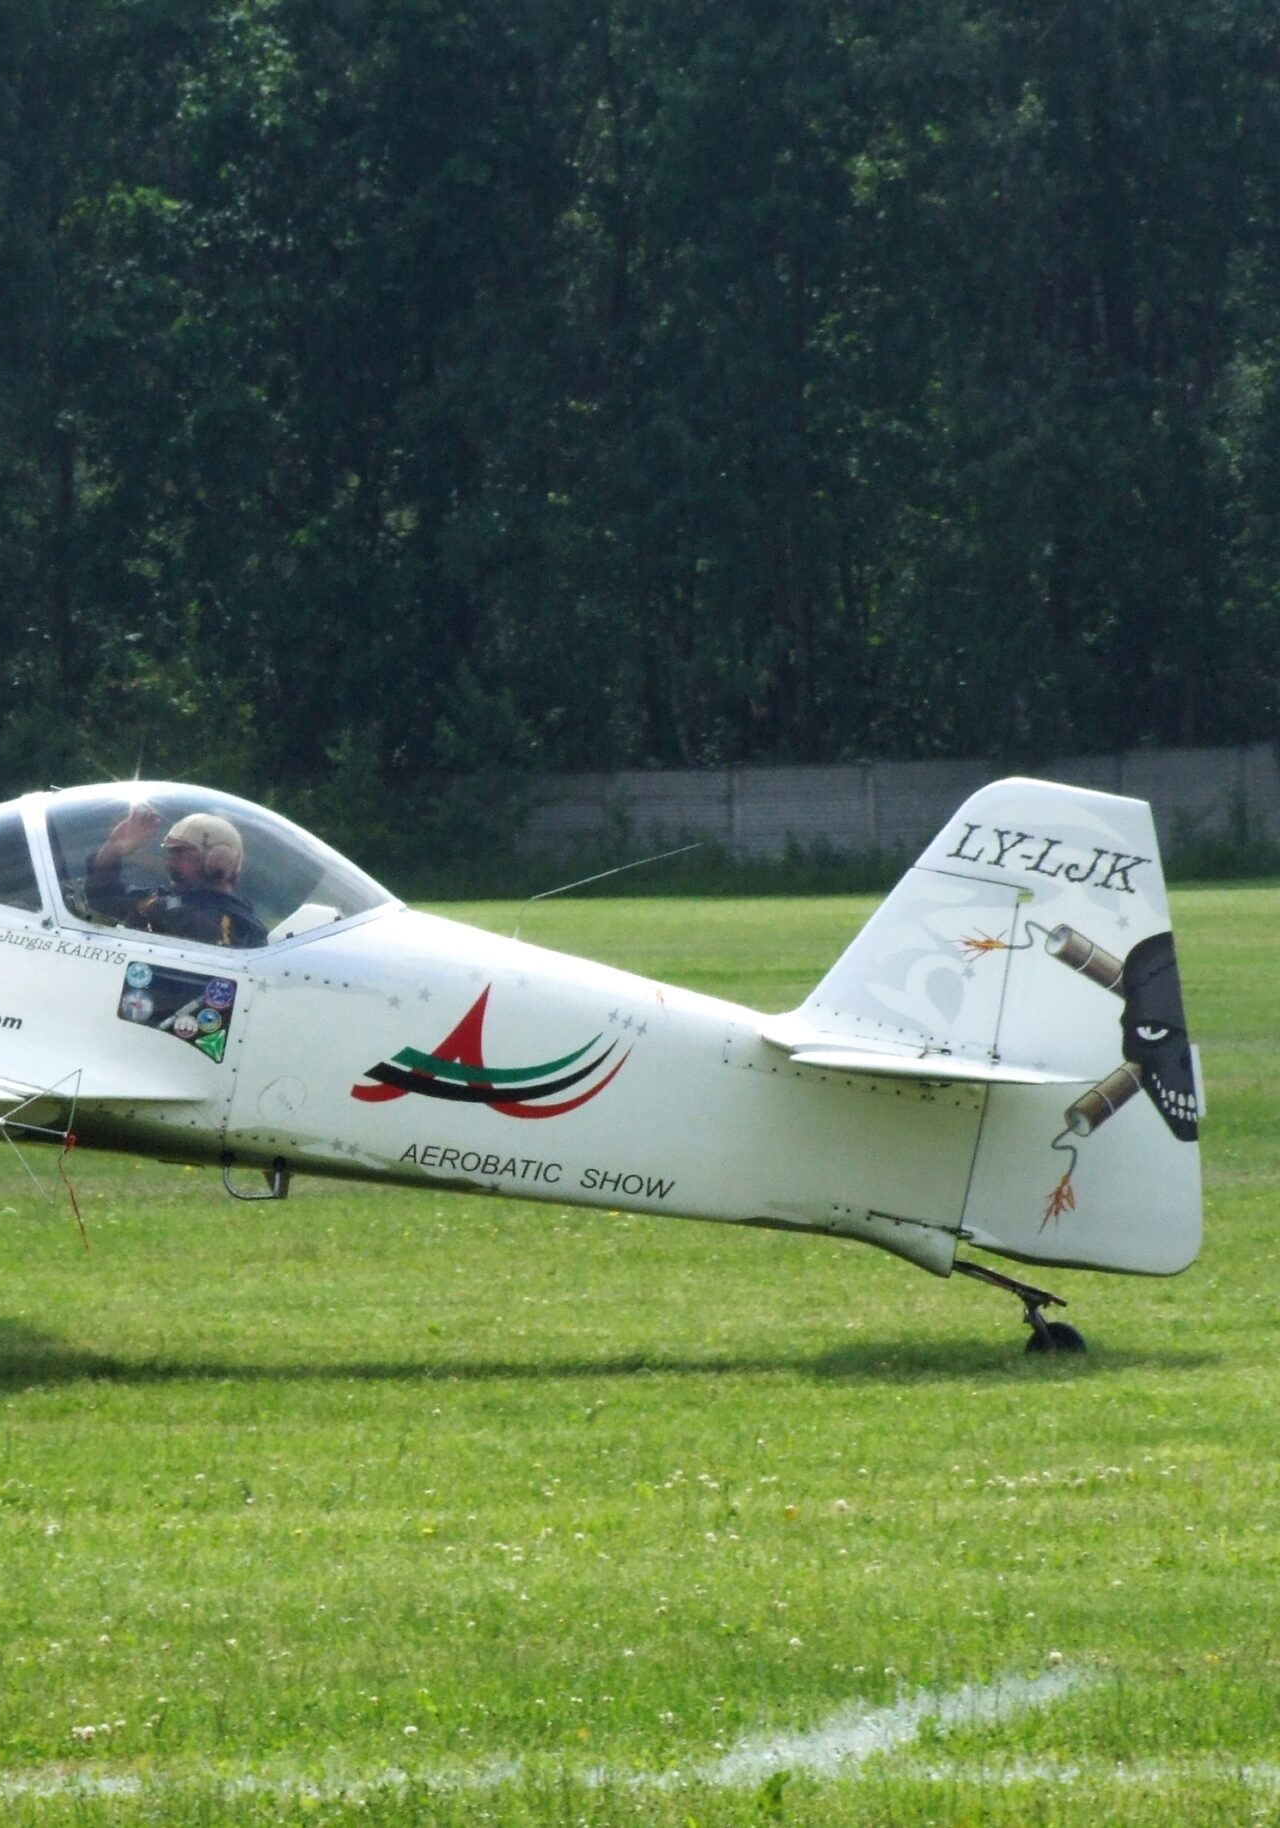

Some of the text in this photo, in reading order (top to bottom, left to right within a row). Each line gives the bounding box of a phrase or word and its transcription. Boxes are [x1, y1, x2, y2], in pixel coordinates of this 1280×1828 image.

[946, 822, 1152, 894] LY-LJK
[55, 939, 127, 965] KAIRYS
[399, 1143, 676, 1199] AEROBATIC SHOW
